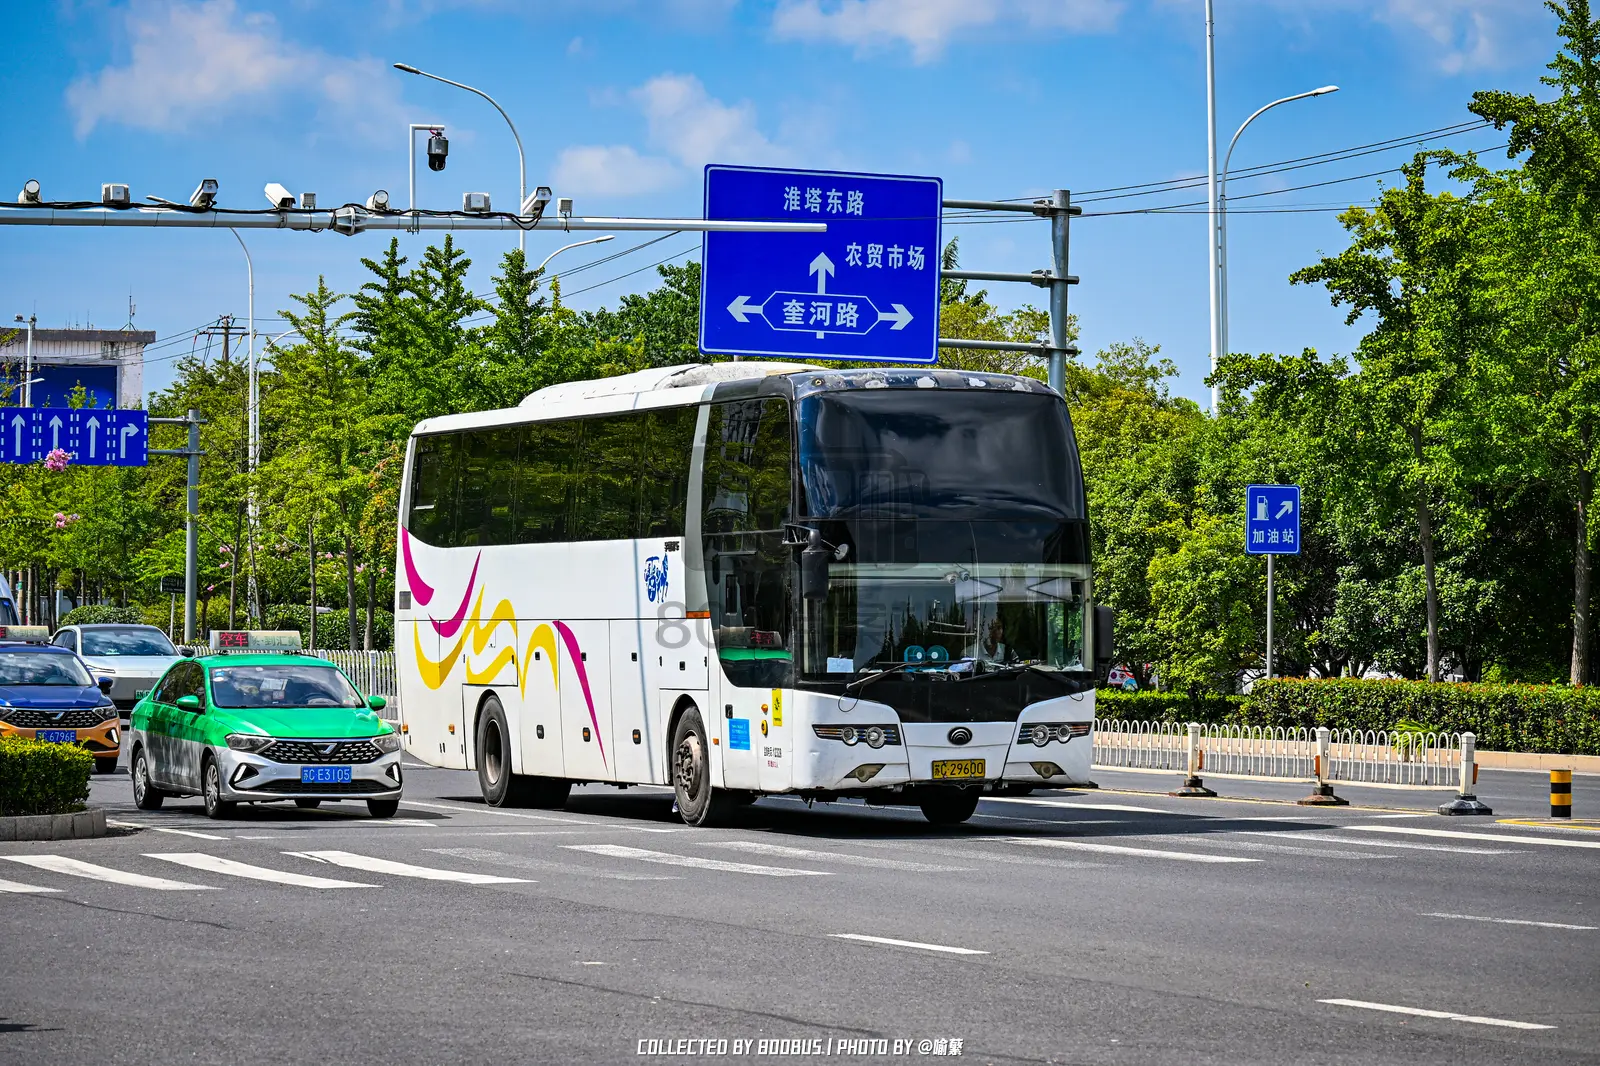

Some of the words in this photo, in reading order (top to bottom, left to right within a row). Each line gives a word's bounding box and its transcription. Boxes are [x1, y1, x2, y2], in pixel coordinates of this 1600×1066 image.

[783, 186, 865, 216] 淮塔东路
[845, 242, 925, 271] 农贸市场
[782, 299, 860, 328] 奎河路
[1252, 528, 1294, 544] 加油站
[220, 632, 248, 647] 空车
